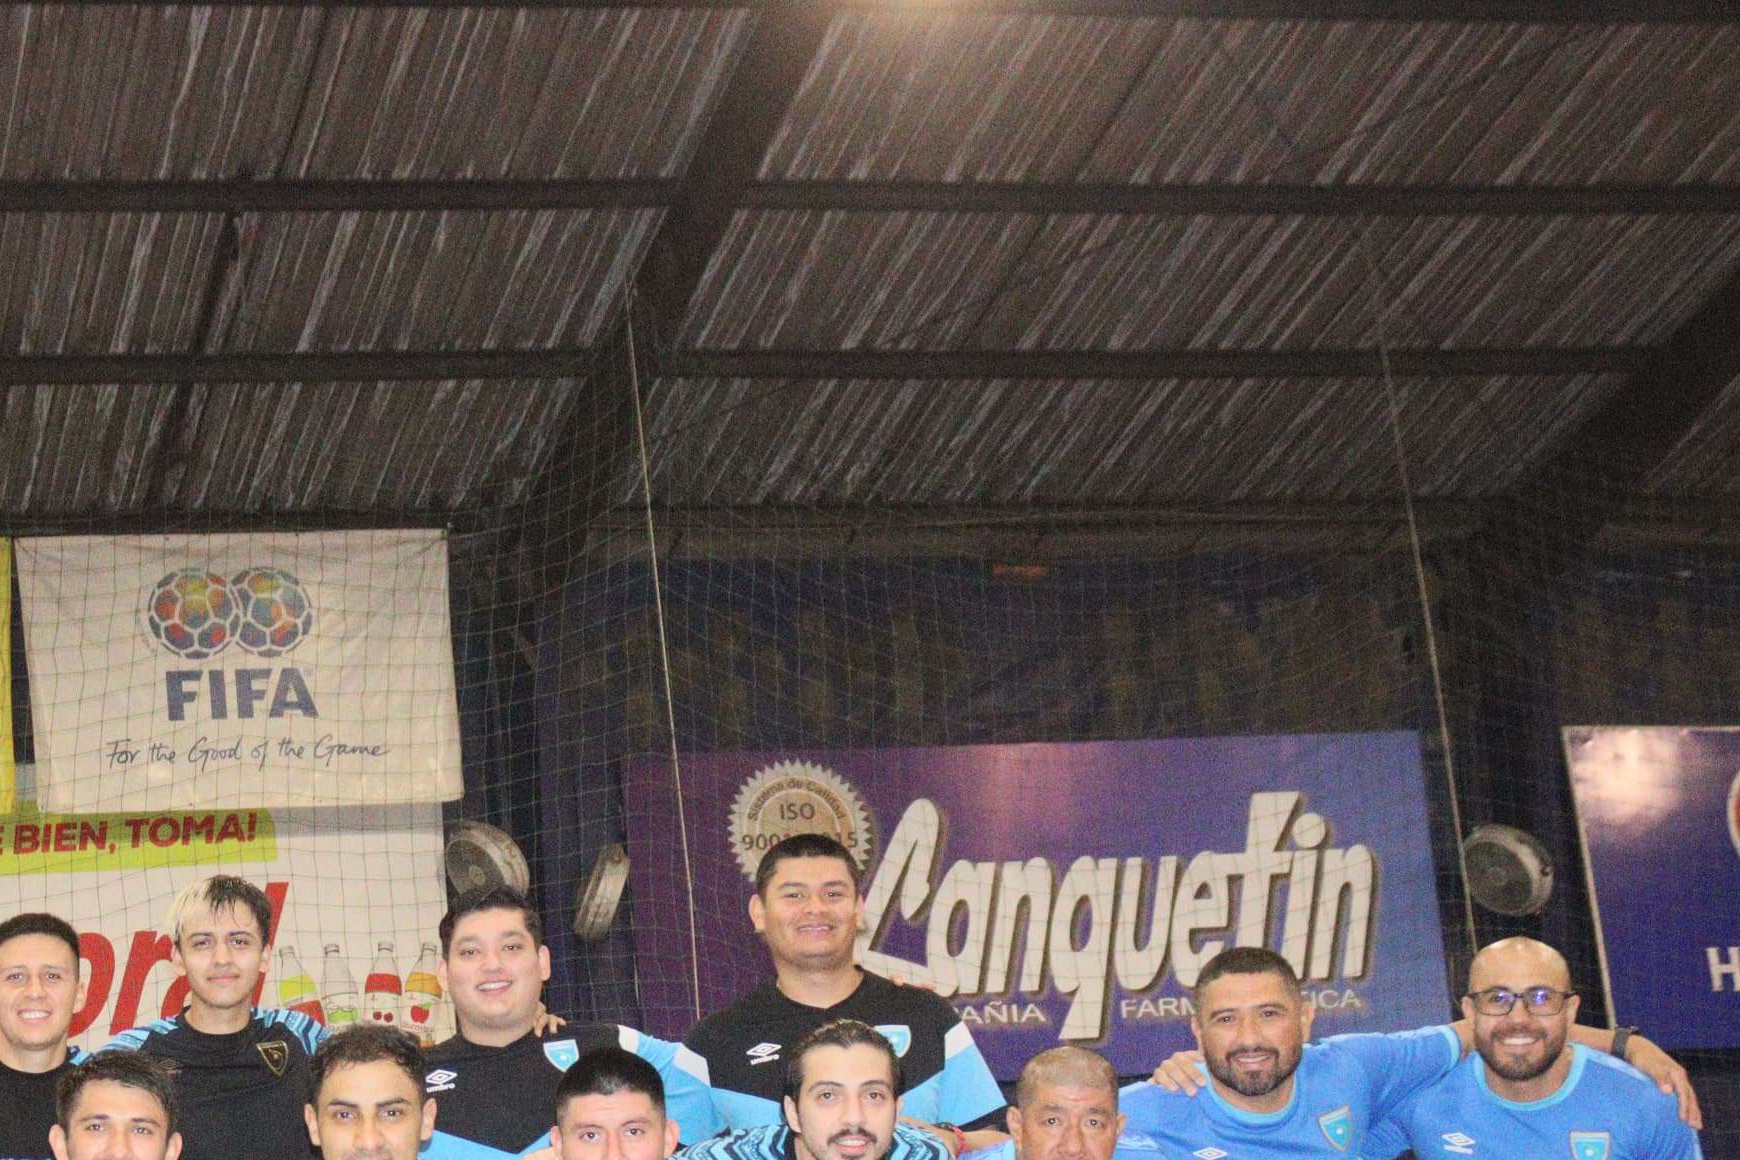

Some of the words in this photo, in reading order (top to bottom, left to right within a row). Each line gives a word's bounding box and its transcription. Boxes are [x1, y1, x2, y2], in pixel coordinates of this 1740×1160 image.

[165, 667, 319, 721] FIFA
[106, 738, 138, 768] For
[150, 742, 176, 763] the
[188, 736, 242, 772] Good
[251, 738, 269, 772] of
[278, 738, 306, 760] the
[315, 734, 391, 766] Game
[780, 802, 816, 820] ISO
[13, 820, 117, 855] BIEN,
[125, 812, 258, 848] TOMA!
[426, 1083, 456, 1093] umbro
